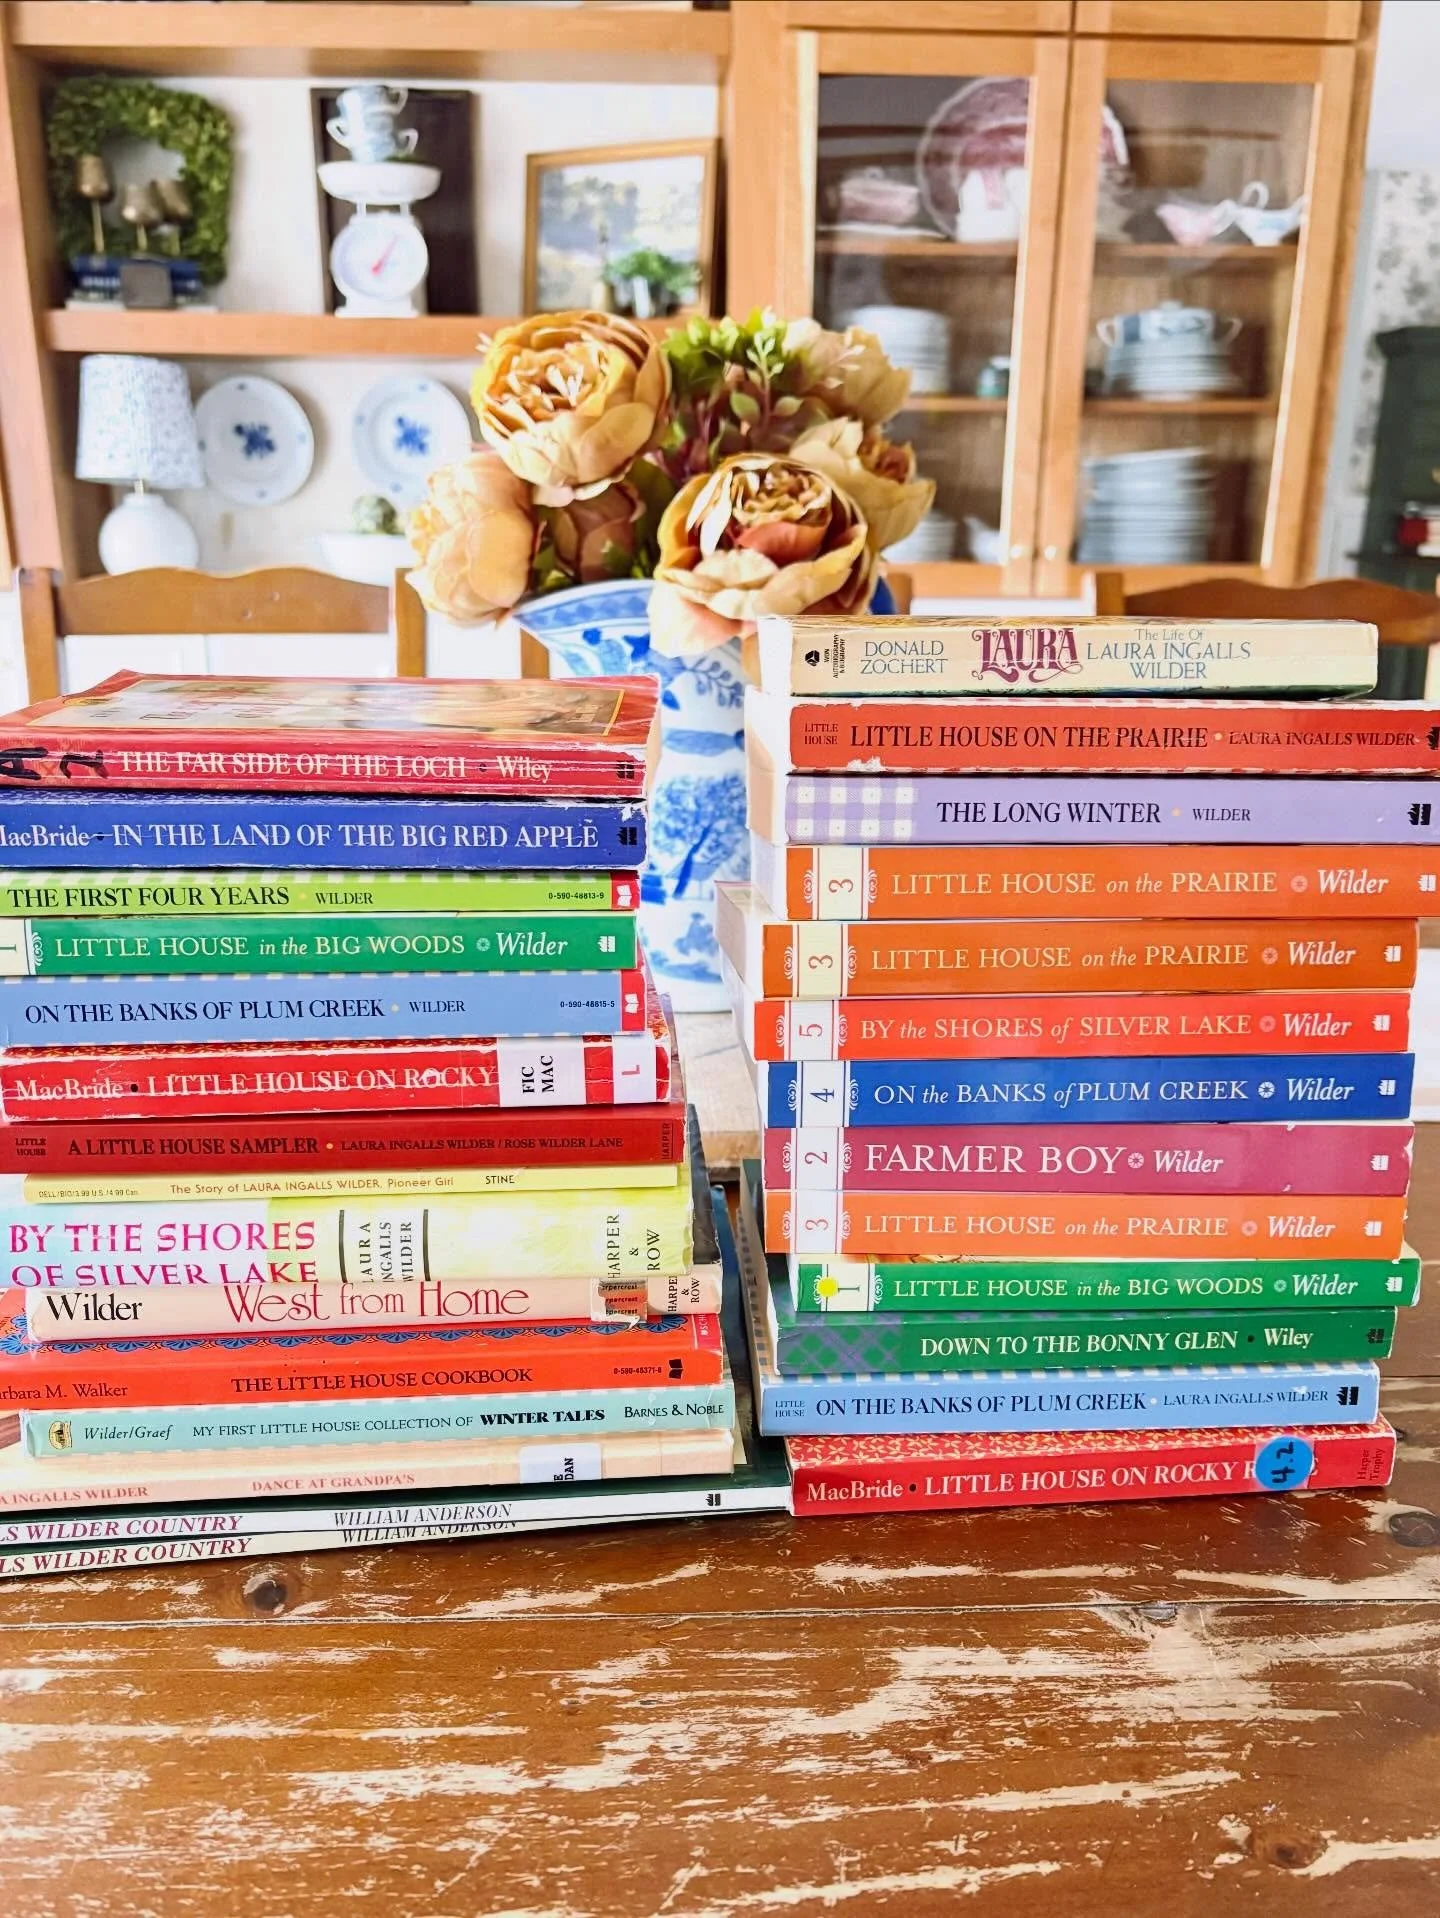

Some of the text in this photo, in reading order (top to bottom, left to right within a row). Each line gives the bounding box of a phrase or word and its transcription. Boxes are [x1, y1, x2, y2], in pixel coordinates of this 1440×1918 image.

[1135, 628, 1204, 641] The Life Of
[864, 640, 944, 657] DONALD
[971, 627, 1083, 683] LAURA
[1087, 642, 1251, 660] LAURA INGALLS
[860, 658, 948, 675] ZOCHERT
[1130, 661, 1208, 680] WILDER
[804, 723, 839, 733] LITTLE
[850, 725, 1416, 748] LITTLE HOUSE ON THE PRAIRIE LAURA INGALLS WILDER
[804, 735, 838, 745] HOUSE
[117, 751, 552, 783] THE FAR SIDE OF THE LOCH Wiley
[937, 802, 1251, 823] THE LONG WINTER WILDER
[112, 825, 141, 846] IN
[149, 825, 205, 846] THE
[213, 825, 290, 846] LAND
[296, 825, 331, 846] OF
[339, 825, 394, 847] THE
[400, 825, 446, 847] BIG
[453, 825, 508, 847] RED
[828, 879, 854, 894] 3
[892, 869, 1388, 895] LITTLE HOUSE on the PRAIRIE Wilder
[7, 886, 373, 908] THE FIRST FOUR YEARS WILDER
[55, 932, 568, 957] LITTLE HOUSE in the BIG WOODS Wilder
[522, 1066, 535, 1094] FIC
[541, 1055, 554, 1093] MAC
[622, 1065, 641, 1076] L
[68, 1137, 318, 1155] A LITTLE HOUSE SAMPLER
[804, 1151, 828, 1165] 2
[864, 1143, 1224, 1174] FARMER BOY Wilder
[171, 1184, 191, 1194] The
[195, 1183, 223, 1196] Story
[227, 1182, 239, 1193] of
[243, 1182, 281, 1193] LAURA
[286, 1180, 333, 1191] INGALLS
[388, 1178, 430, 1188] Pioneer
[435, 1177, 454, 1187] Girl
[485, 1175, 515, 1185] STINE
[9, 1221, 315, 1253] BY THE SHORES
[606, 1214, 620, 1279] HARPER
[629, 1247, 639, 1256] &
[647, 1229, 661, 1271] ROW
[11, 1262, 318, 1287] OF SILVER LAKE
[47, 1292, 143, 1321] Wilder
[224, 1280, 530, 1323] West from Home
[921, 1328, 1313, 1356] DOWN TO THE BONNY GLEN Wiley
[44, 1384, 67, 1398] M.
[72, 1383, 128, 1397] Walker
[231, 1369, 532, 1392] THE LITTLE HOUSE COOKBOOK
[671, 1404, 684, 1416] &
[775, 1400, 805, 1408] LITTLE
[775, 1409, 805, 1418] HOUSE
[816, 1390, 1328, 1416] ON THE BANKS OF PLUM CREEK LAURA INGALLS WILDER
[84, 1425, 173, 1440] Wilder/Graef
[193, 1409, 605, 1437] MY FIRST LITTLE HOUSE COLLECTION OF WINTER TALES
[554, 1474, 563, 1482] E
[564, 1458, 574, 1480] DAN
[252, 1473, 415, 1491] DANCE AT GRANDPA'S
[806, 1480, 903, 1501] MacBride
[924, 1474, 1014, 1495] LITTLE
[1020, 1468, 1105, 1490] HOUSE
[1111, 1466, 1148, 1486] ON
[1153, 1461, 1238, 1484] ROCKY
[334, 1504, 512, 1526] WILLIAM ANDERSON
[26, 1521, 119, 1541] WILDER
[126, 1515, 243, 1536] COUNTRY
